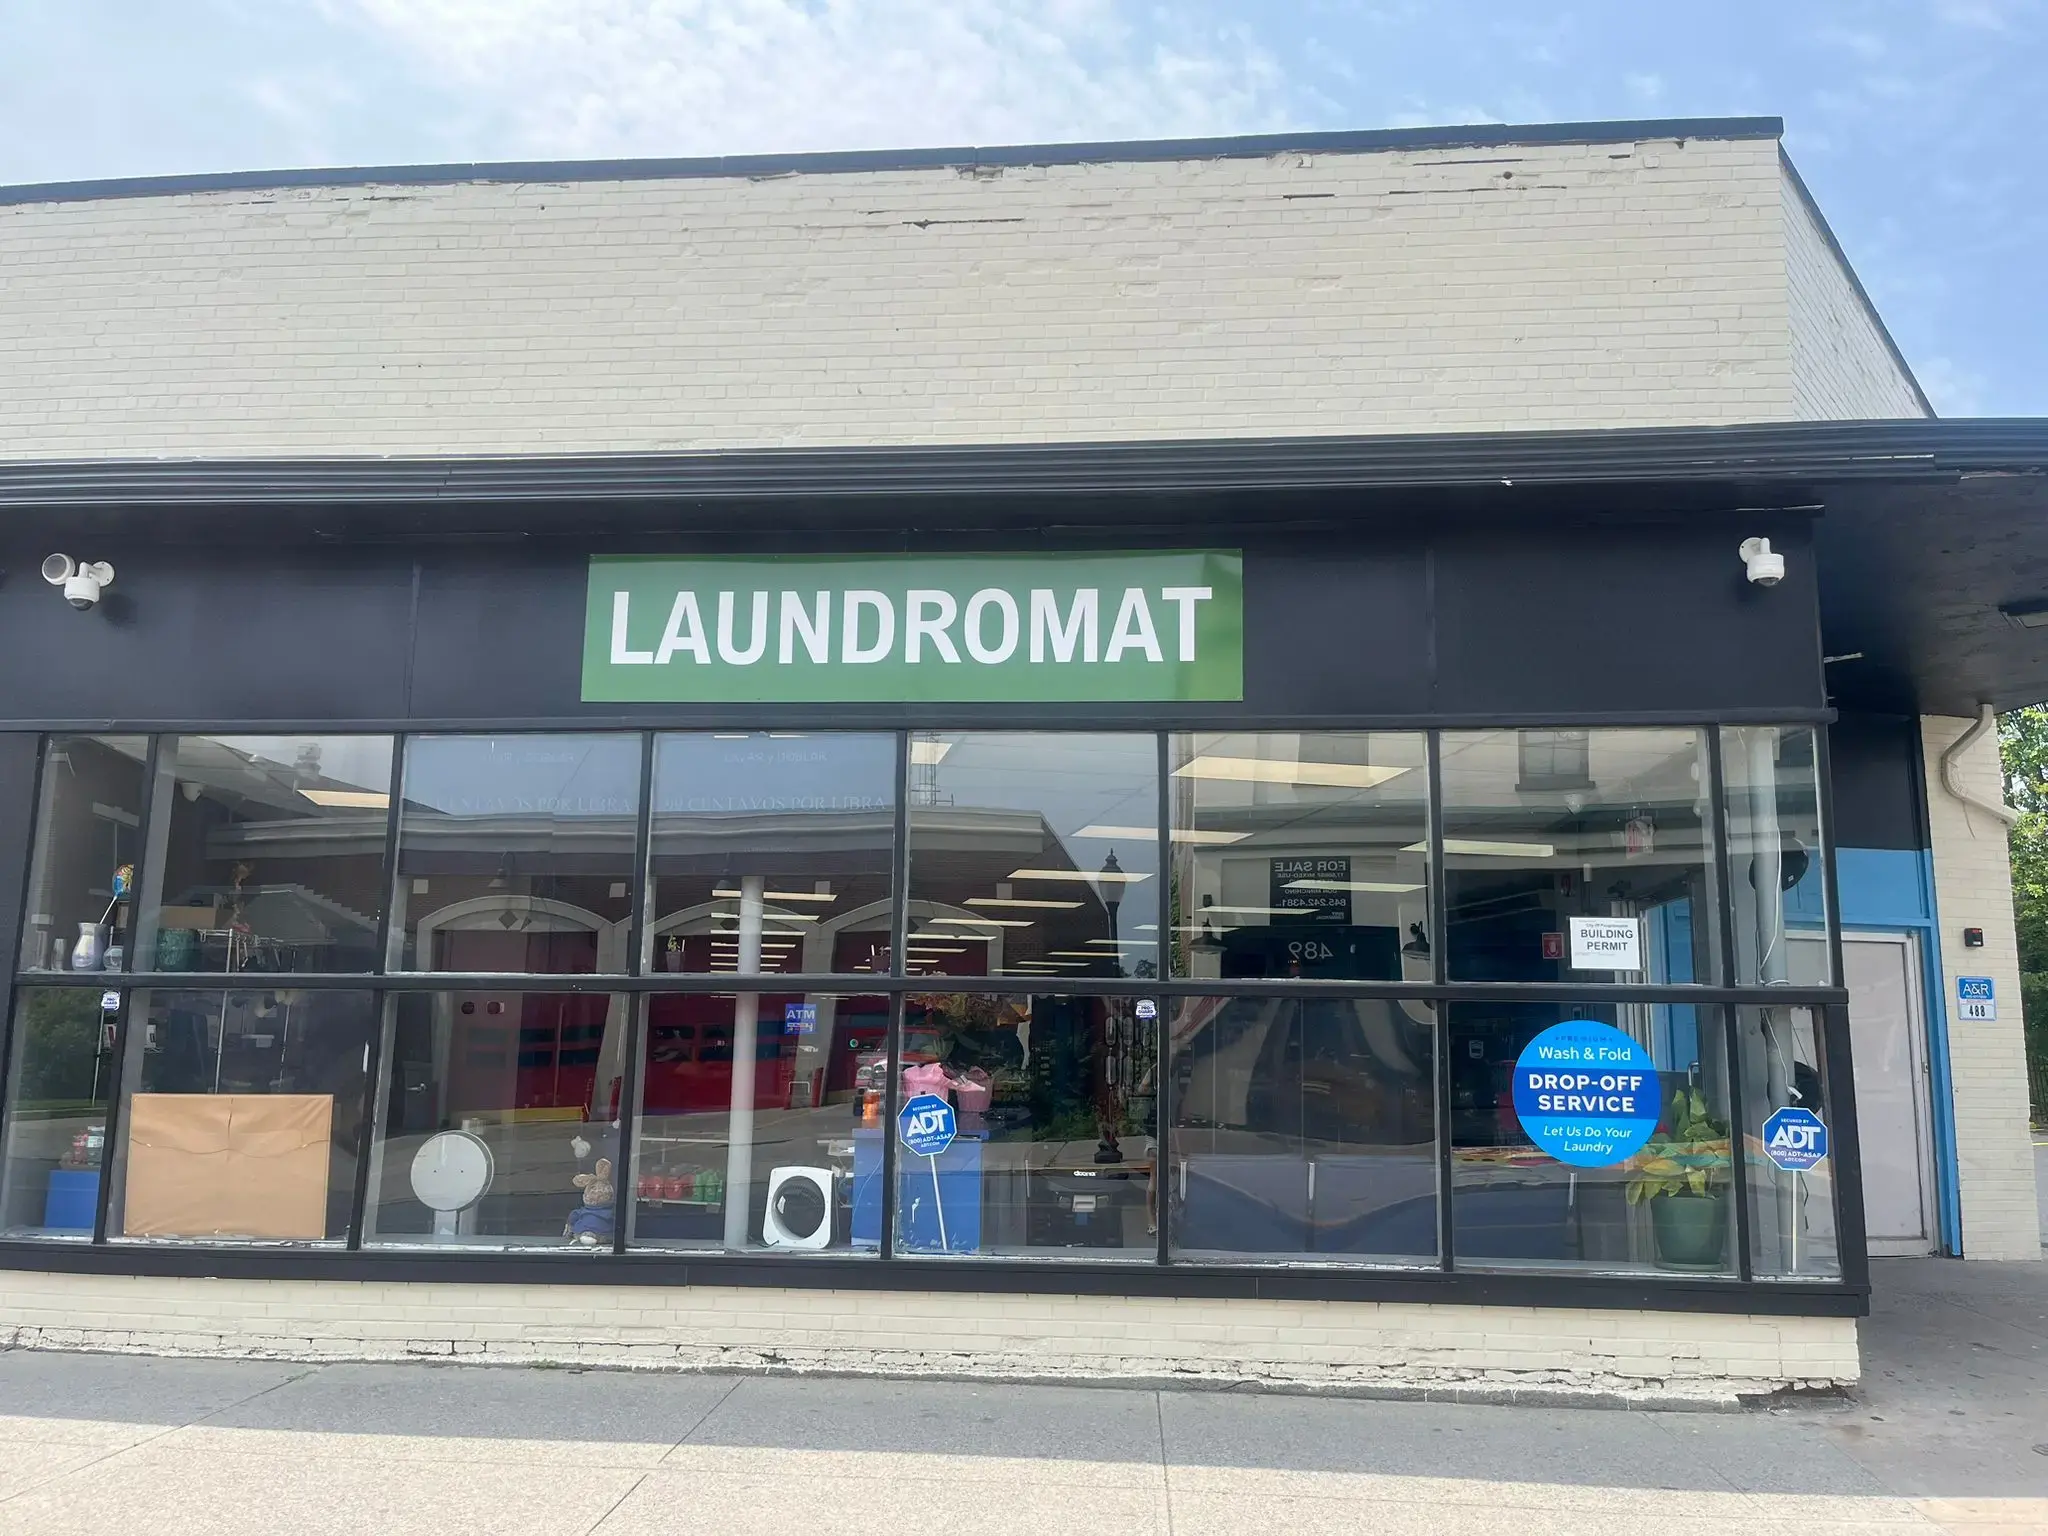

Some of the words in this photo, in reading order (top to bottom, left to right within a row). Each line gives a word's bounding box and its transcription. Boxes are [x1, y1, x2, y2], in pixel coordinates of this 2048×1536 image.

[610, 587, 1212, 665] LAUNDROMAT
[791, 796, 825, 811] POR
[1580, 929, 1633, 939] BUILDING
[1587, 942, 1628, 951] PERMIT
[1962, 983, 1990, 996] A&R
[786, 1009, 815, 1019] ATM
[1969, 1005, 1986, 1017] 488
[1538, 1046, 1579, 1060] Wash
[1583, 1047, 1595, 1060] &
[1599, 1047, 1631, 1061] Fold
[1529, 1073, 1643, 1091] DROP-OFF
[1538, 1095, 1635, 1112] SERVICE
[906, 1108, 948, 1137] ADT
[1544, 1125, 1562, 1136] Let
[1566, 1126, 1581, 1136] Us
[1584, 1127, 1601, 1137] Do
[1606, 1127, 1632, 1138] Your
[1770, 1125, 1821, 1150] ADT
[923, 1133, 952, 1144] ADT-ASAP
[1564, 1141, 1614, 1154] Laundry
